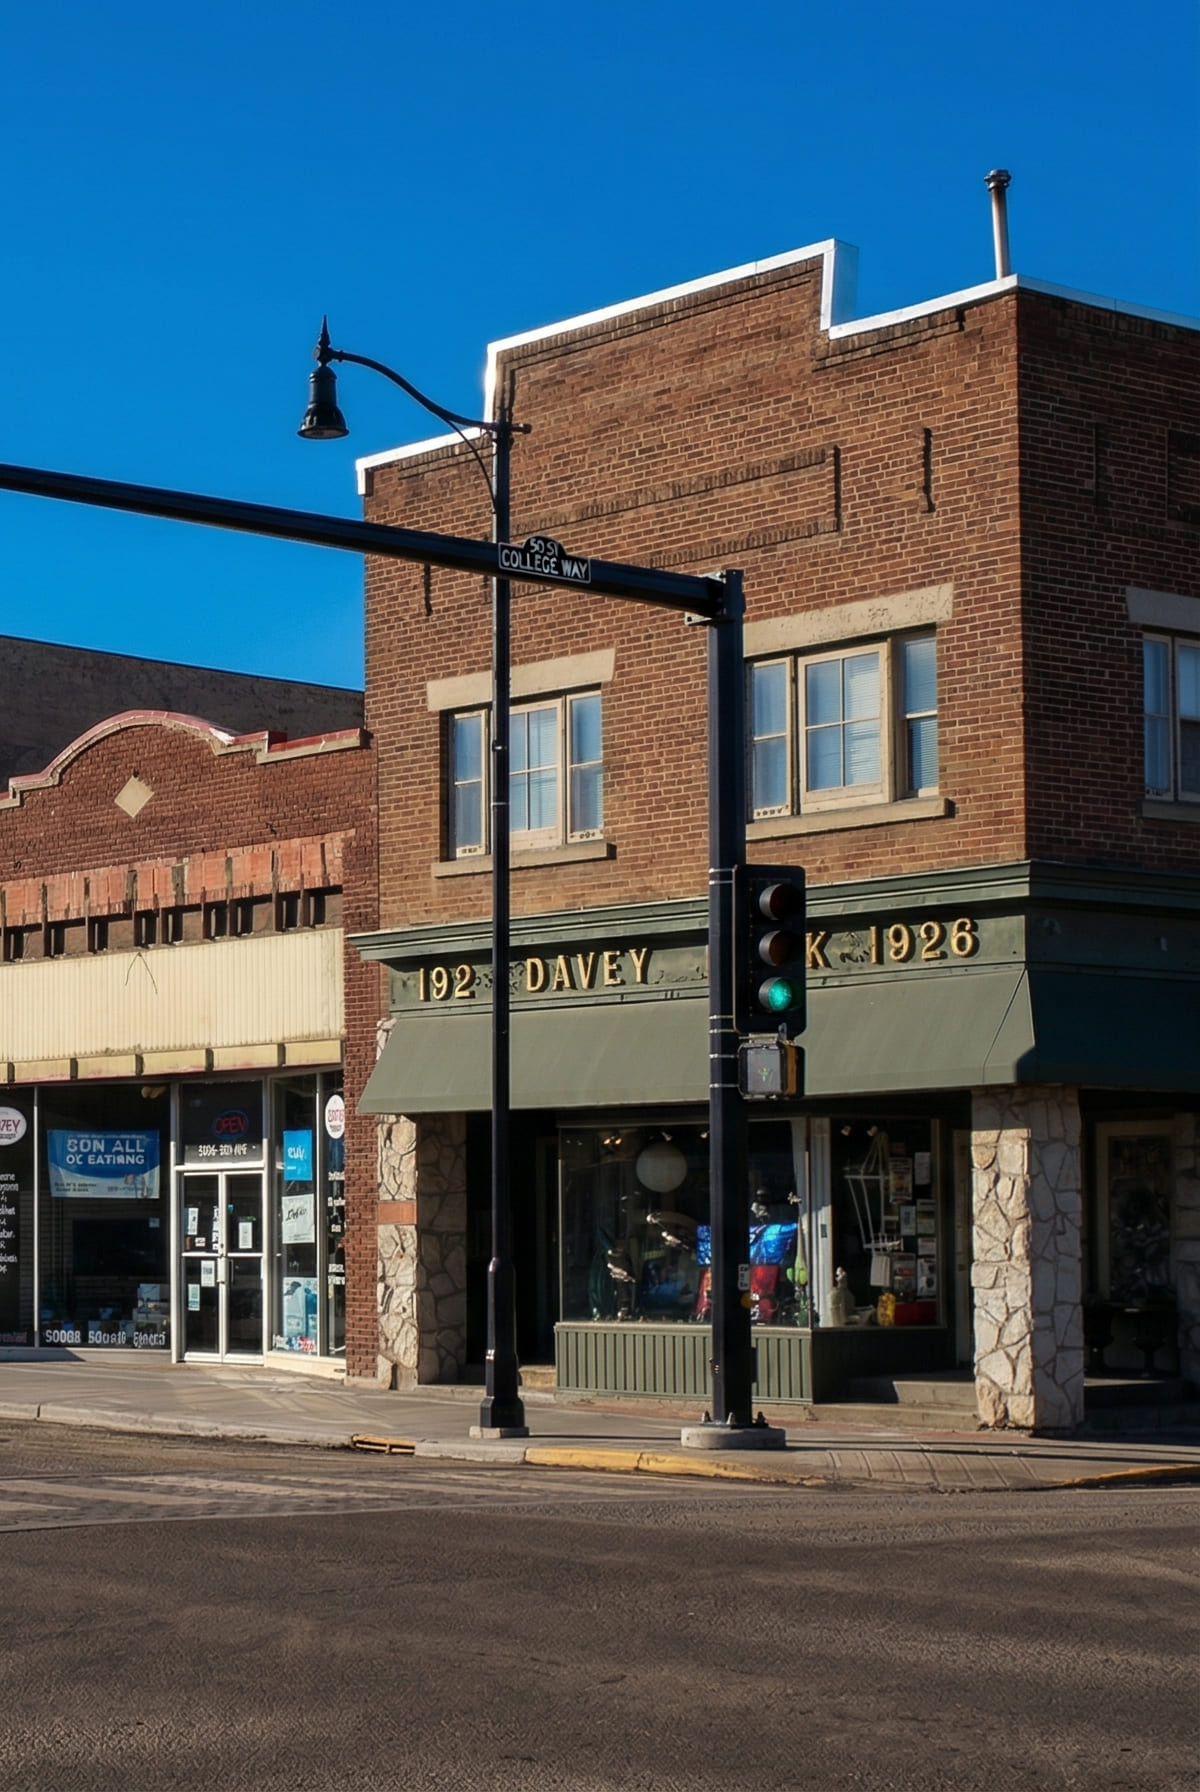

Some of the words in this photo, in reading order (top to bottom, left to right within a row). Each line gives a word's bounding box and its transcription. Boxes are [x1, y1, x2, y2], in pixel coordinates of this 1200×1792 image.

[529, 538, 545, 554] 50
[502, 549, 559, 575] COLLEGE
[561, 559, 588, 579] WAY
[526, 948, 648, 992] DAVEY
[869, 917, 975, 964] 1926
[112, 1139, 145, 1153] ALL
